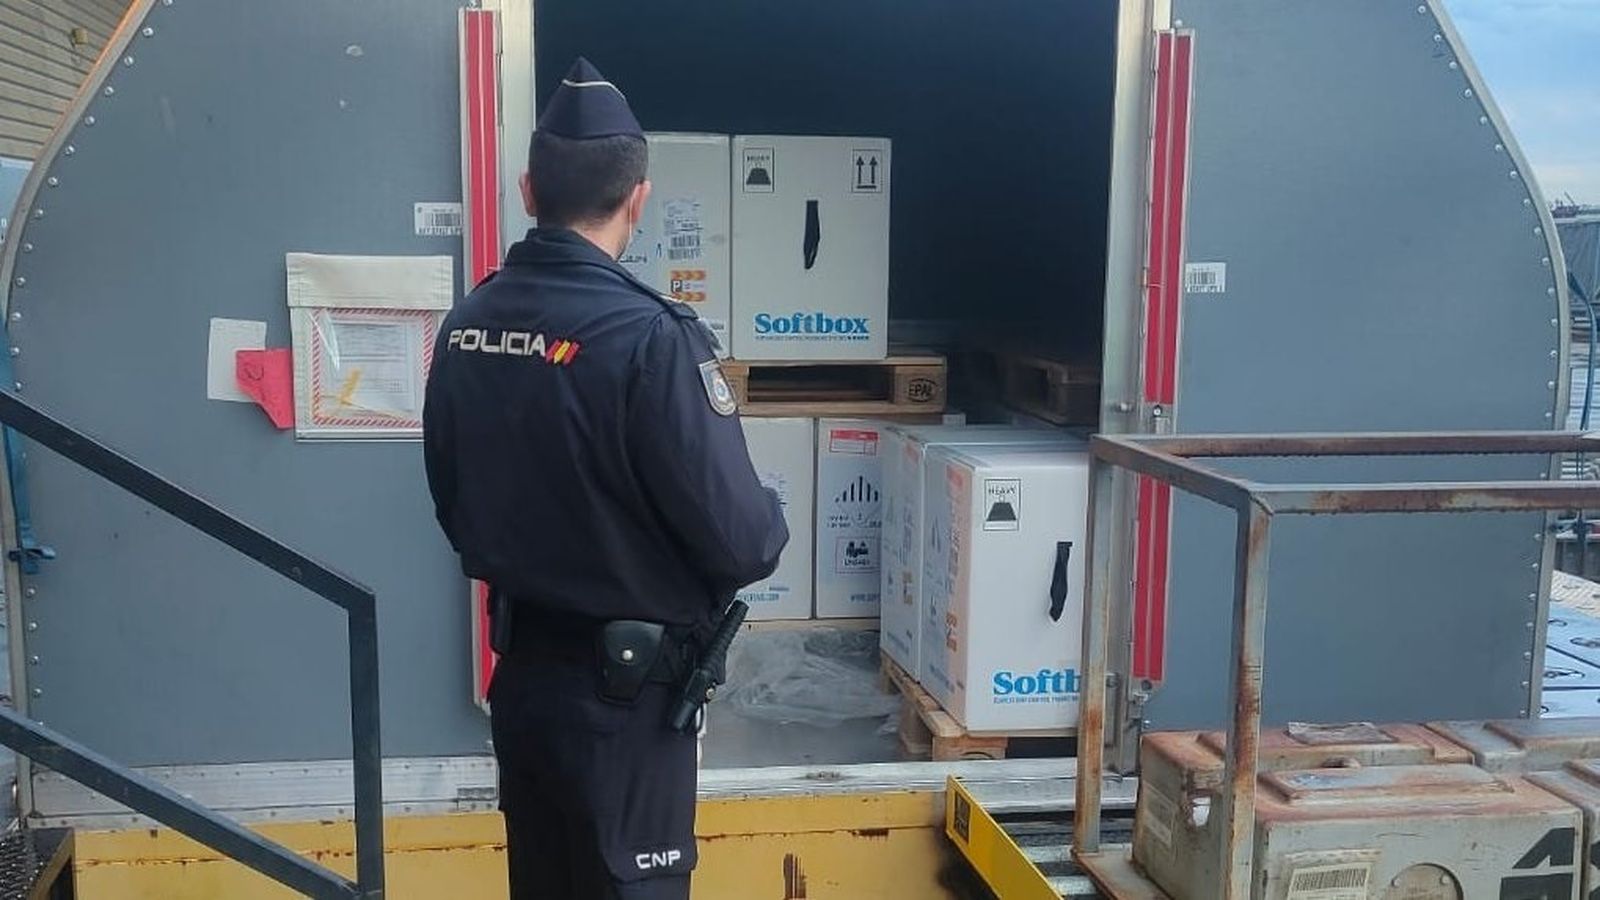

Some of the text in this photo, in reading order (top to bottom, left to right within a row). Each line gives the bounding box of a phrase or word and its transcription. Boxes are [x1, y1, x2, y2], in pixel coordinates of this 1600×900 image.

[754, 312, 870, 334] Softbox
[447, 328, 547, 358] POLICIA
[635, 849, 681, 870] CNP
